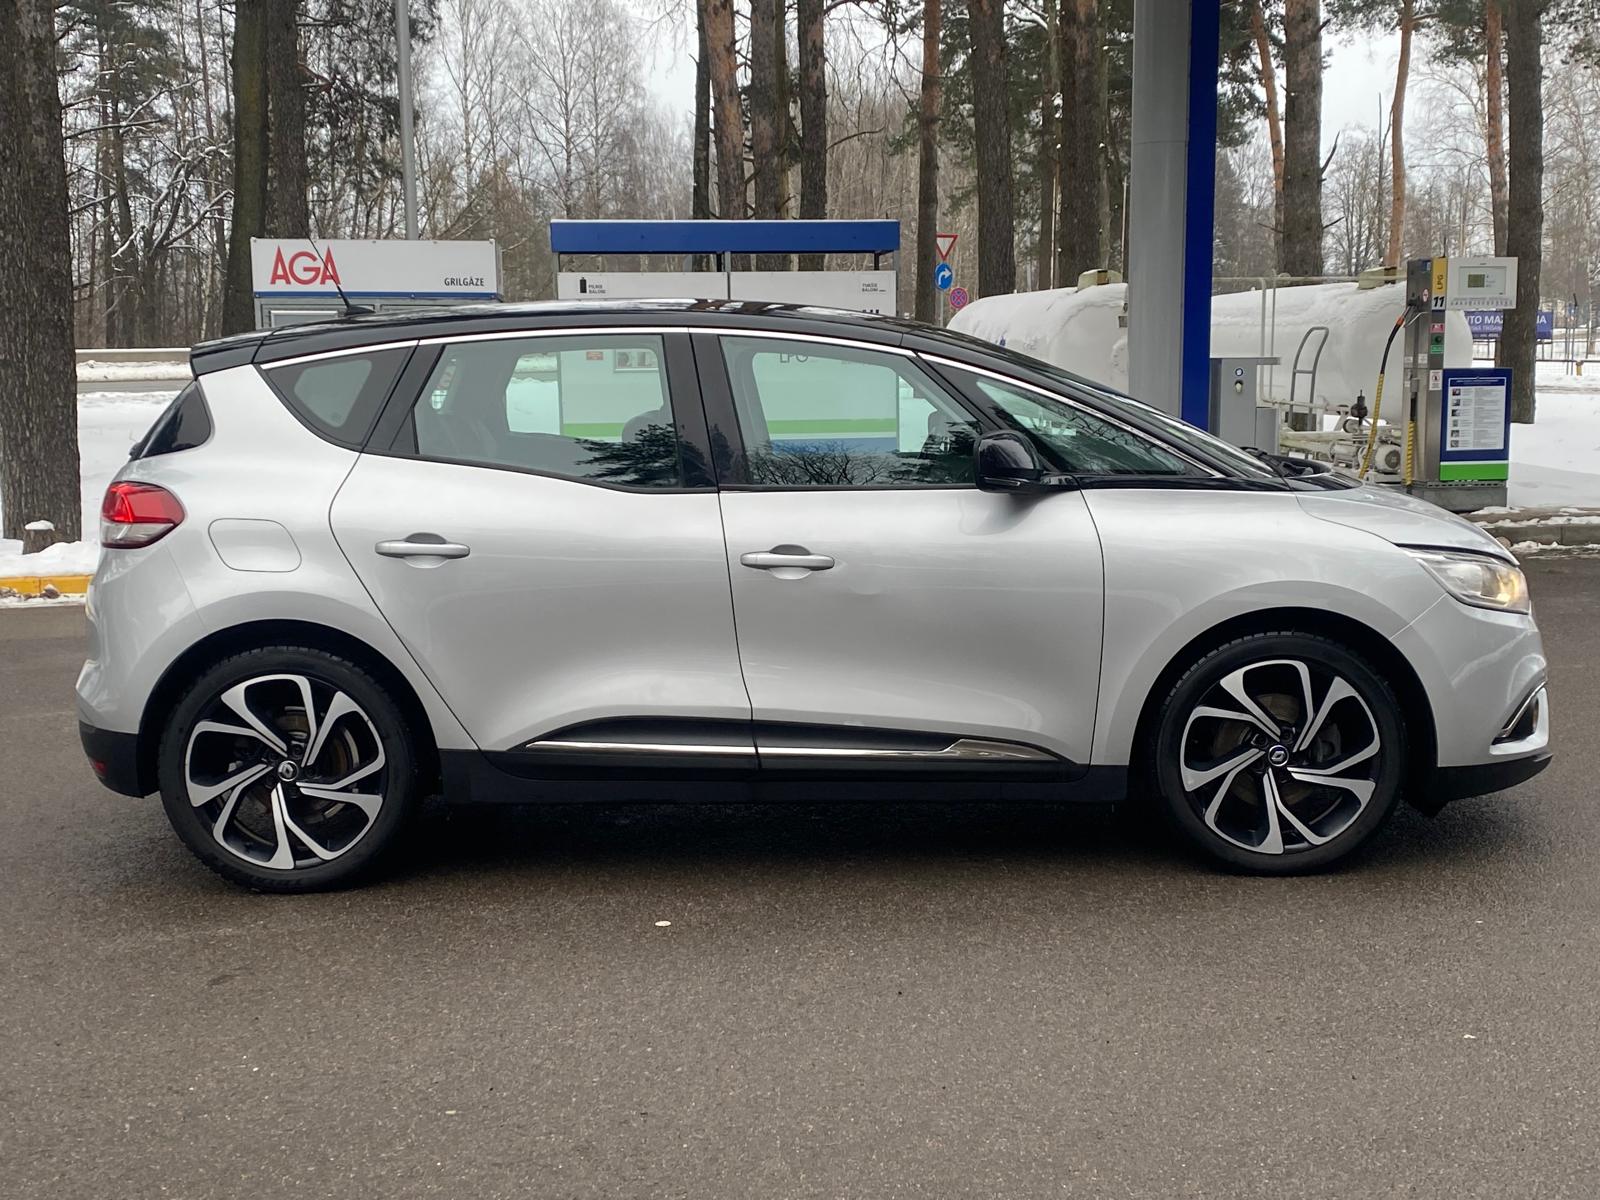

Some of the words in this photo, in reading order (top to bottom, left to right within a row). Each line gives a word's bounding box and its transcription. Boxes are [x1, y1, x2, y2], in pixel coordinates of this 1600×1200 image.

[270, 245, 341, 285] AGA
[1436, 274, 1444, 290] LPG
[1433, 296, 1445, 307] 11
